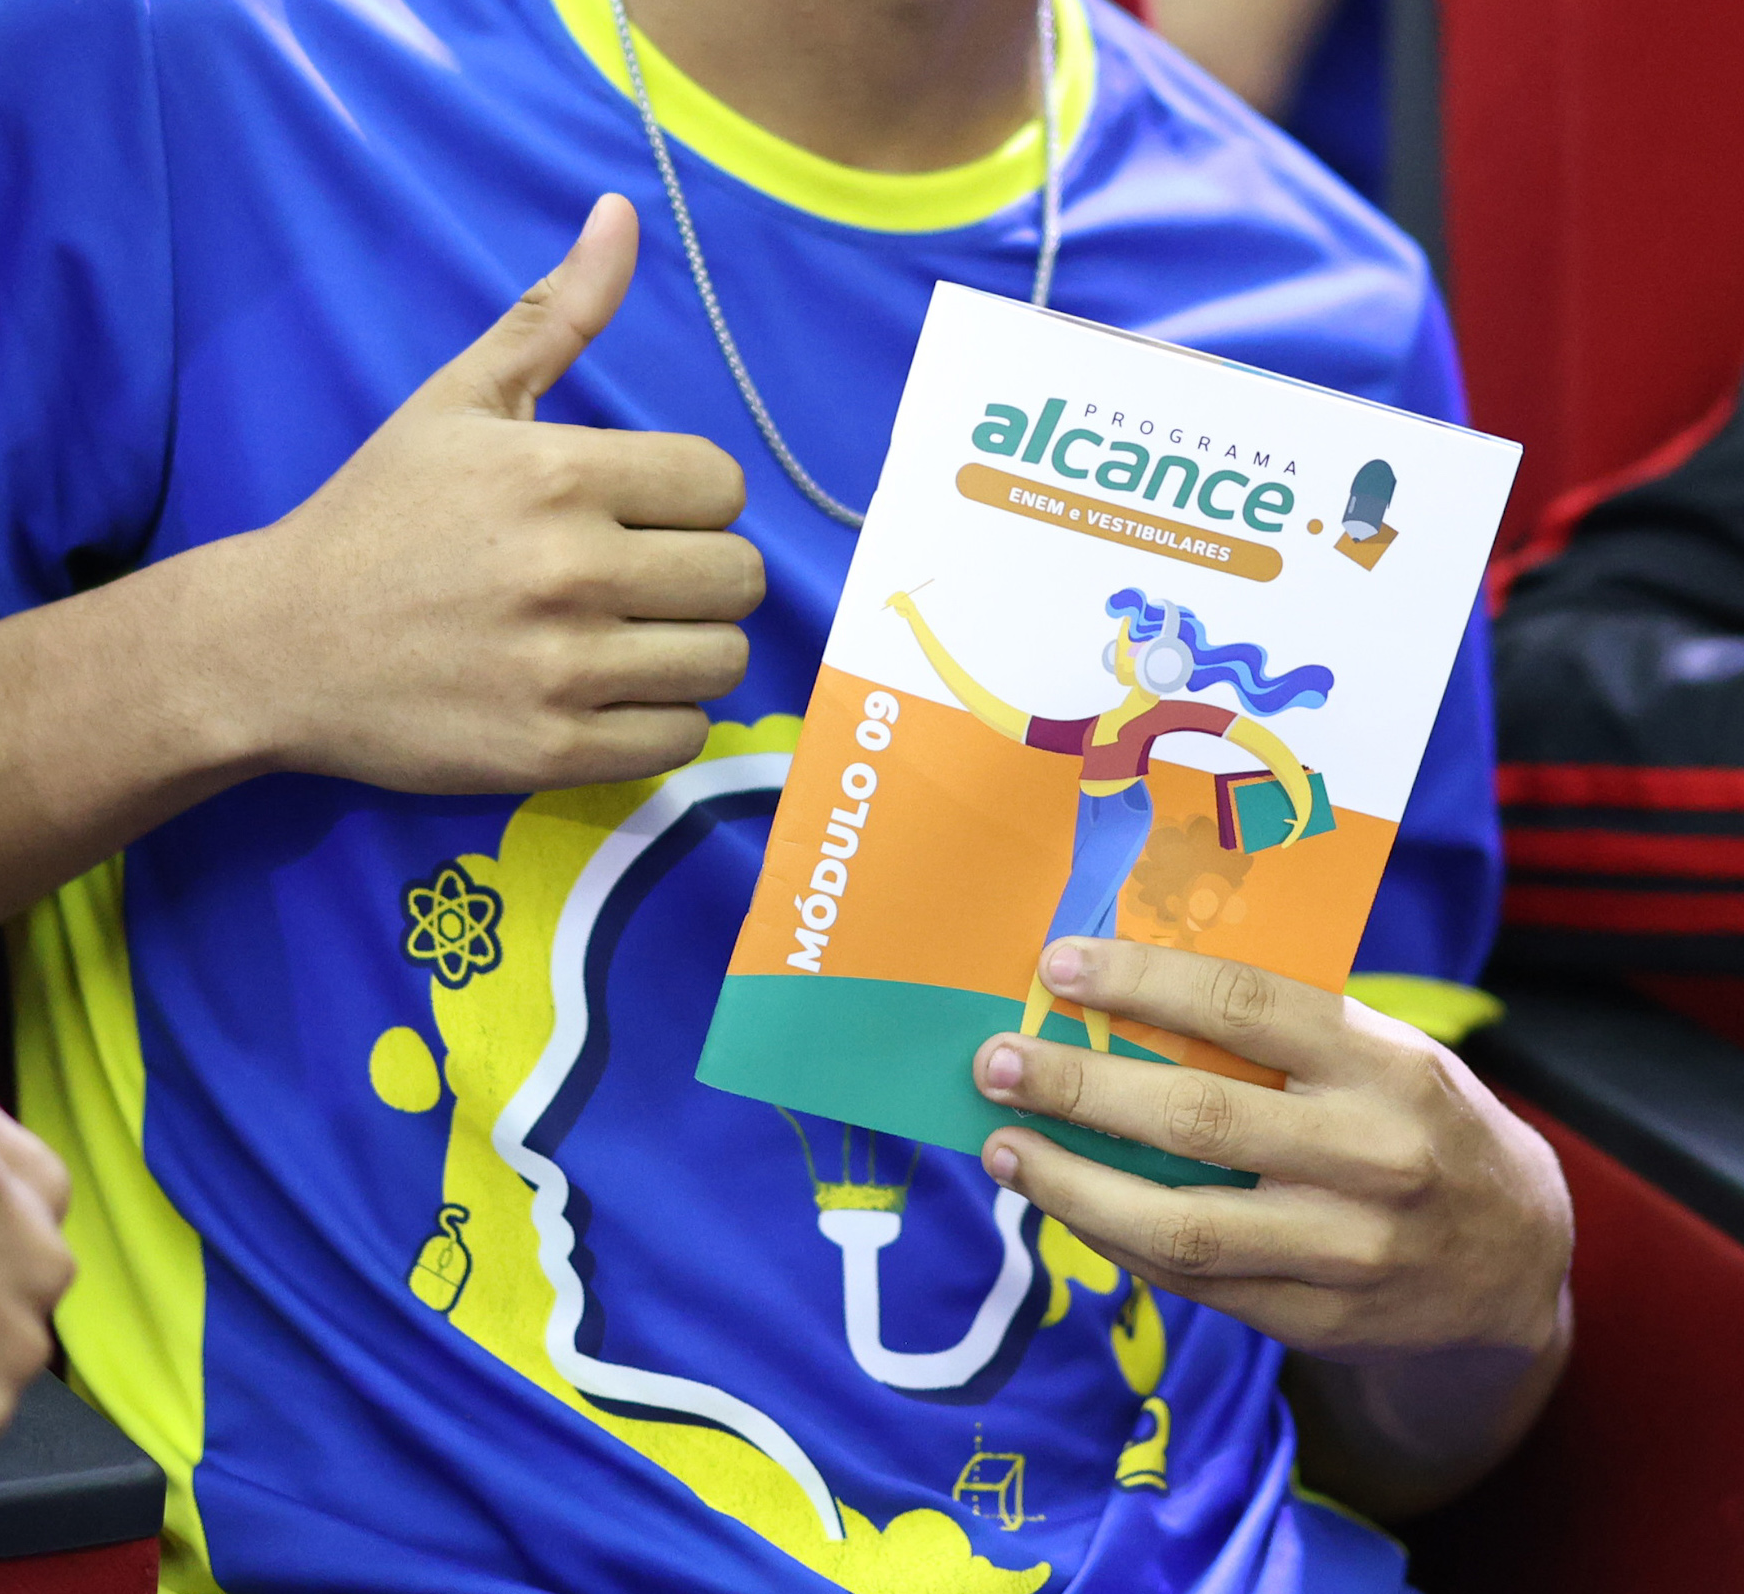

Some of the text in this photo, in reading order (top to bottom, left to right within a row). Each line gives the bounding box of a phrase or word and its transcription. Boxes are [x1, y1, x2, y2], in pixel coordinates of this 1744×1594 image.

[971, 397, 1295, 533] alcance
[1084, 403, 1297, 476] PROGRAMA
[1008, 486, 1232, 562] ENEM e VESTIBULARES
[786, 690, 900, 973] MÓDULO 09
